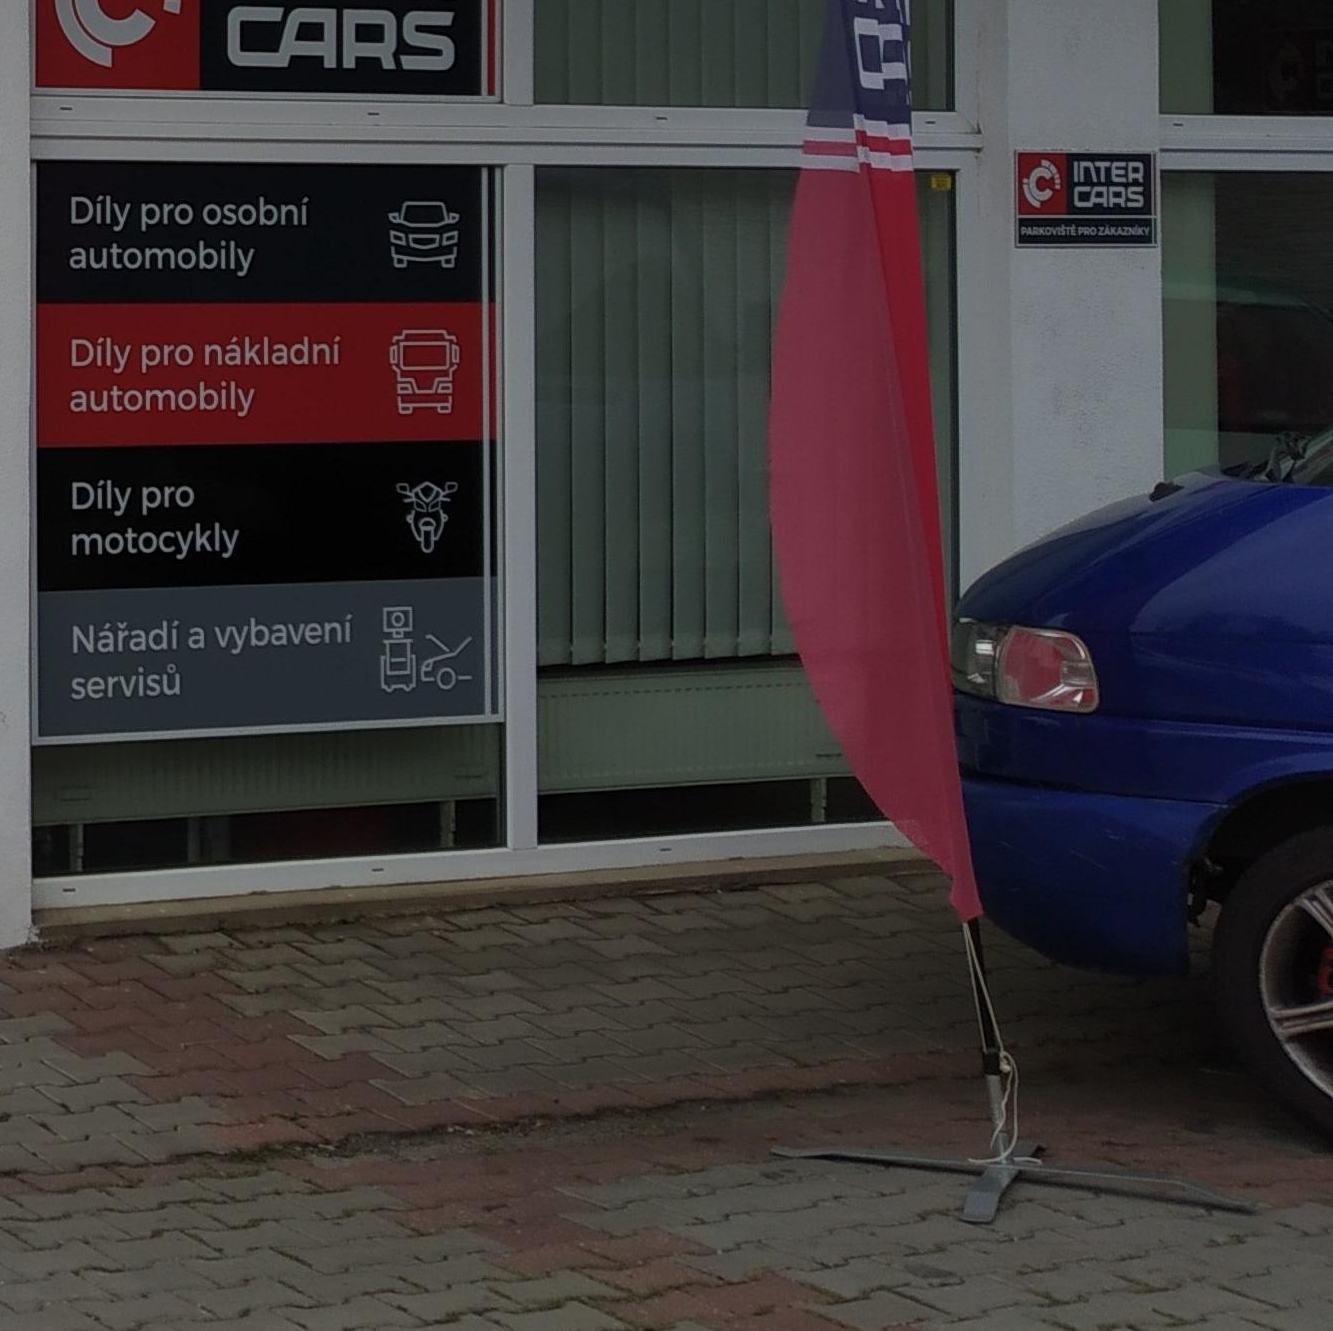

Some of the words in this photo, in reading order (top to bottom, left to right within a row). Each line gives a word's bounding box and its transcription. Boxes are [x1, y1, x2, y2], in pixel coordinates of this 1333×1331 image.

[227, 6, 455, 70] CARS
[1073, 161, 1144, 183] INTER
[70, 196, 130, 232] Díly
[141, 201, 193, 232] pro
[203, 197, 309, 226] osobní
[1073, 186, 1144, 208] CARS
[1021, 224, 1077, 237] PARKOVIŠTĚ
[1078, 227, 1097, 237] PRO
[1098, 224, 1151, 237] ZÁKAZNÍKY
[69, 240, 255, 276] automobily
[70, 337, 131, 373] Díly
[141, 343, 193, 373] pro
[204, 336, 341, 366] nákladní
[69, 382, 255, 417] automobily
[71, 480, 130, 516] Díly
[142, 485, 194, 515] pro
[71, 522, 239, 559] motocykly
[71, 620, 179, 654] Nářadí
[188, 628, 205, 650] a
[215, 615, 353, 654] vybavení
[71, 664, 181, 699] servisů
